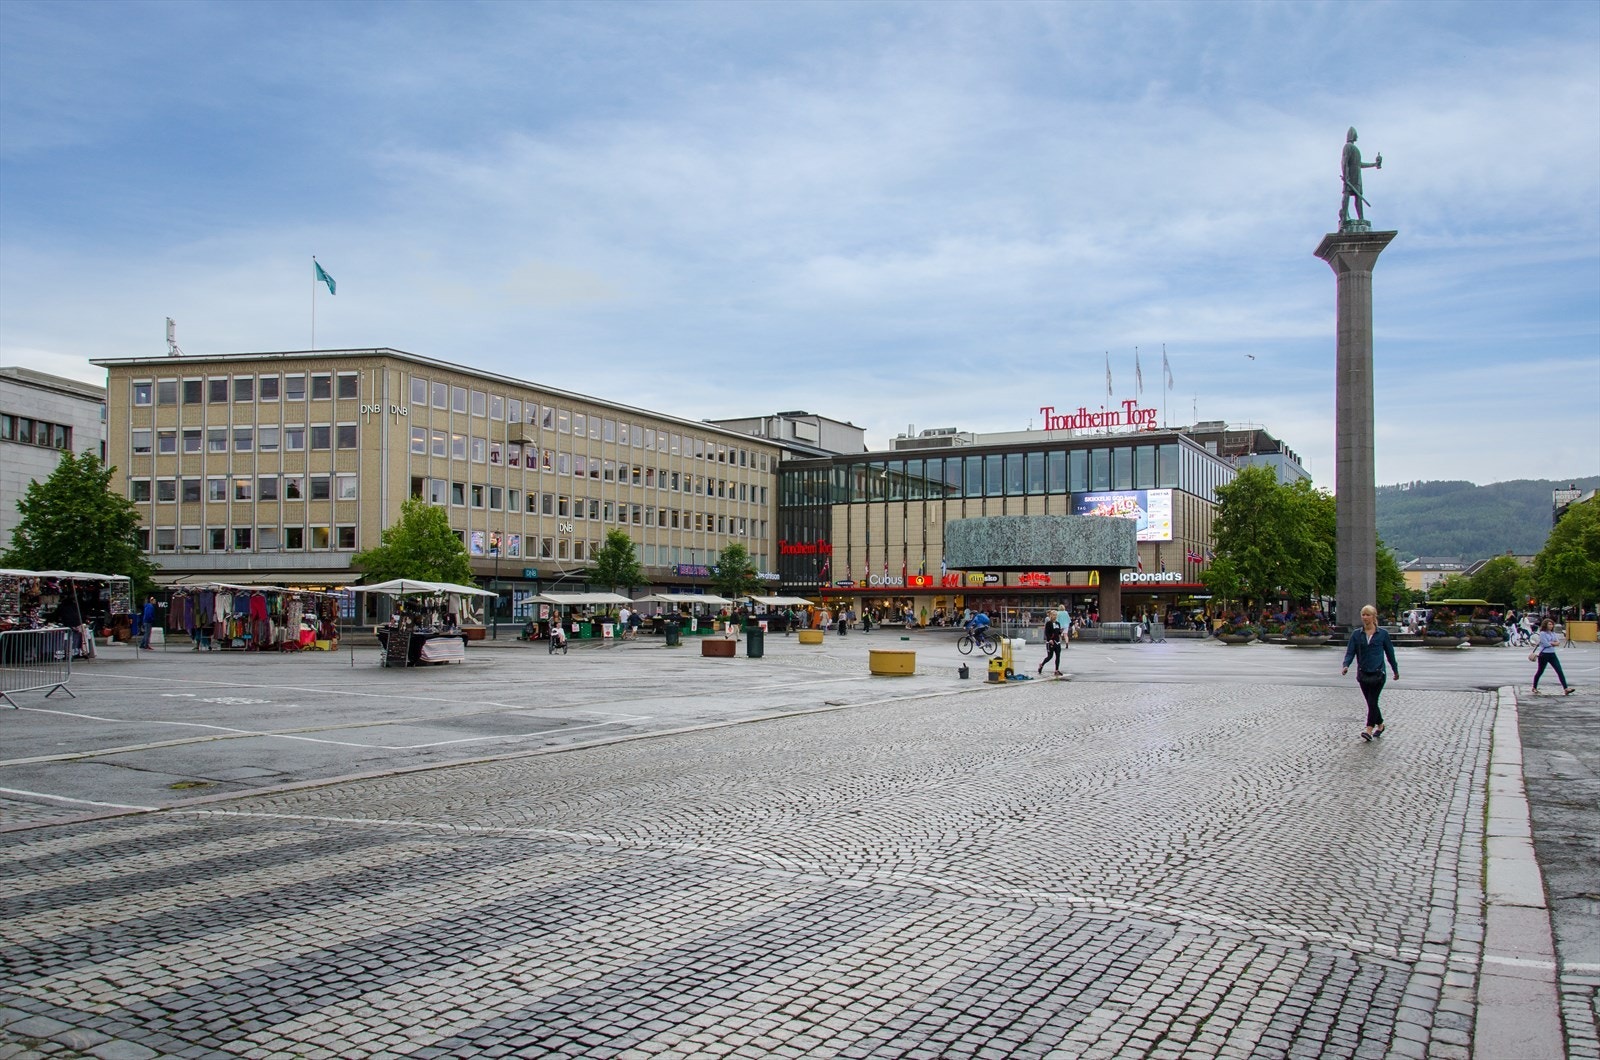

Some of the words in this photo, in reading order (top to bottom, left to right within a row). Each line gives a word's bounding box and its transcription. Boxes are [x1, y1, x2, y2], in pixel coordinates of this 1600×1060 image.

[1040, 405, 1119, 431] Trondheim
[1121, 400, 1157, 430] Torg
[560, 521, 573, 534] DNB
[778, 540, 817, 555] Trondheim
[869, 574, 903, 585] Cubus
